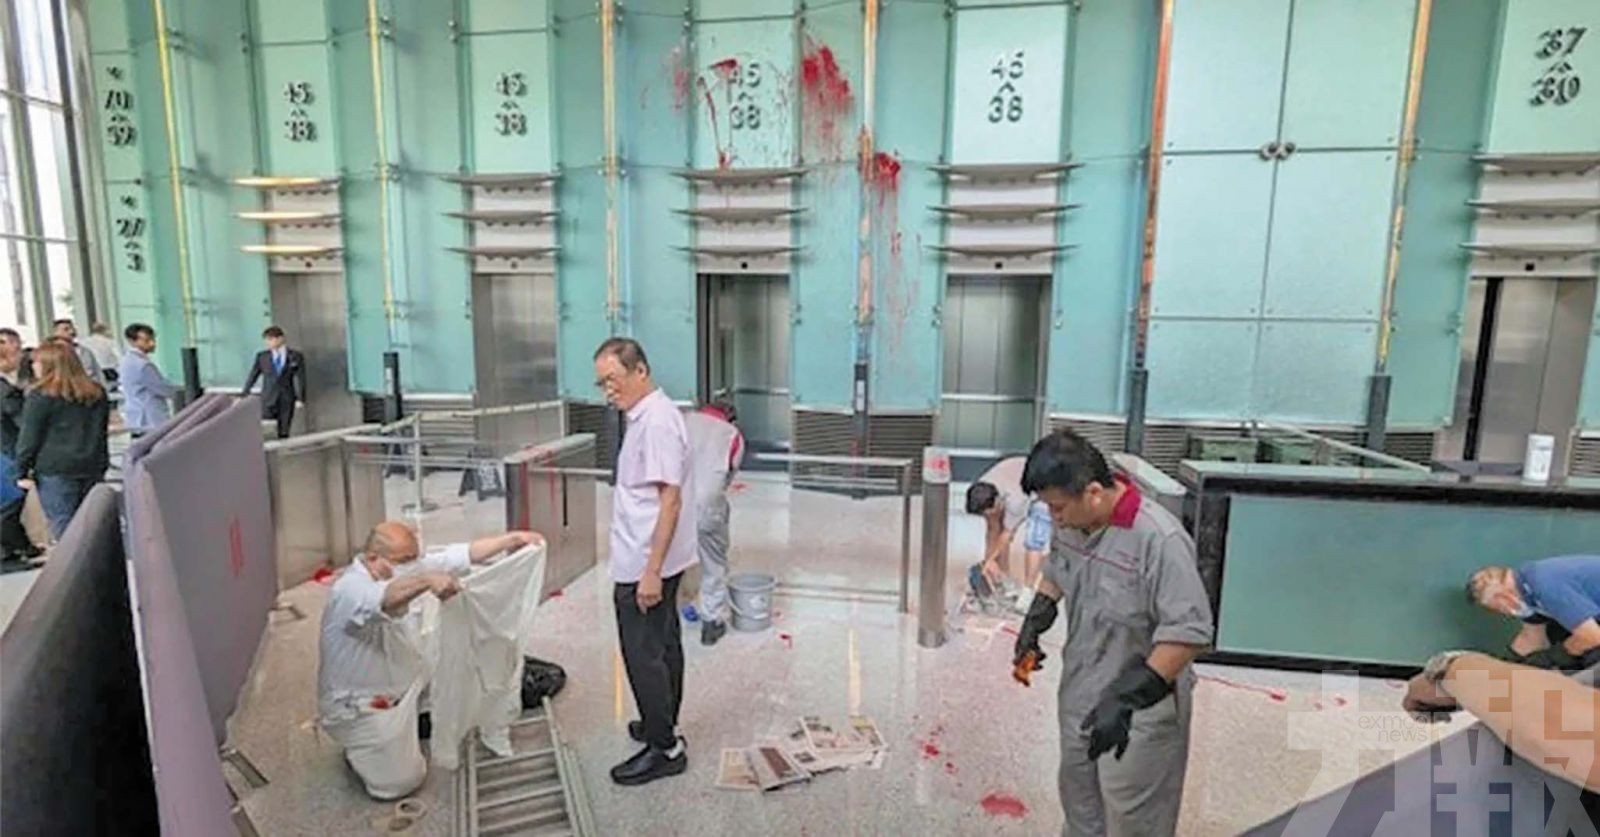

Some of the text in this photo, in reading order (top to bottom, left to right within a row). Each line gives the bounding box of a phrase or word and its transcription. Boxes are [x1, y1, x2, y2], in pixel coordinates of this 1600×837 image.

[1534, 28, 1588, 59] 37
[991, 52, 1023, 79] 45
[1528, 77, 1581, 106] 30
[730, 104, 761, 130] 38
[988, 96, 1023, 123] 38
